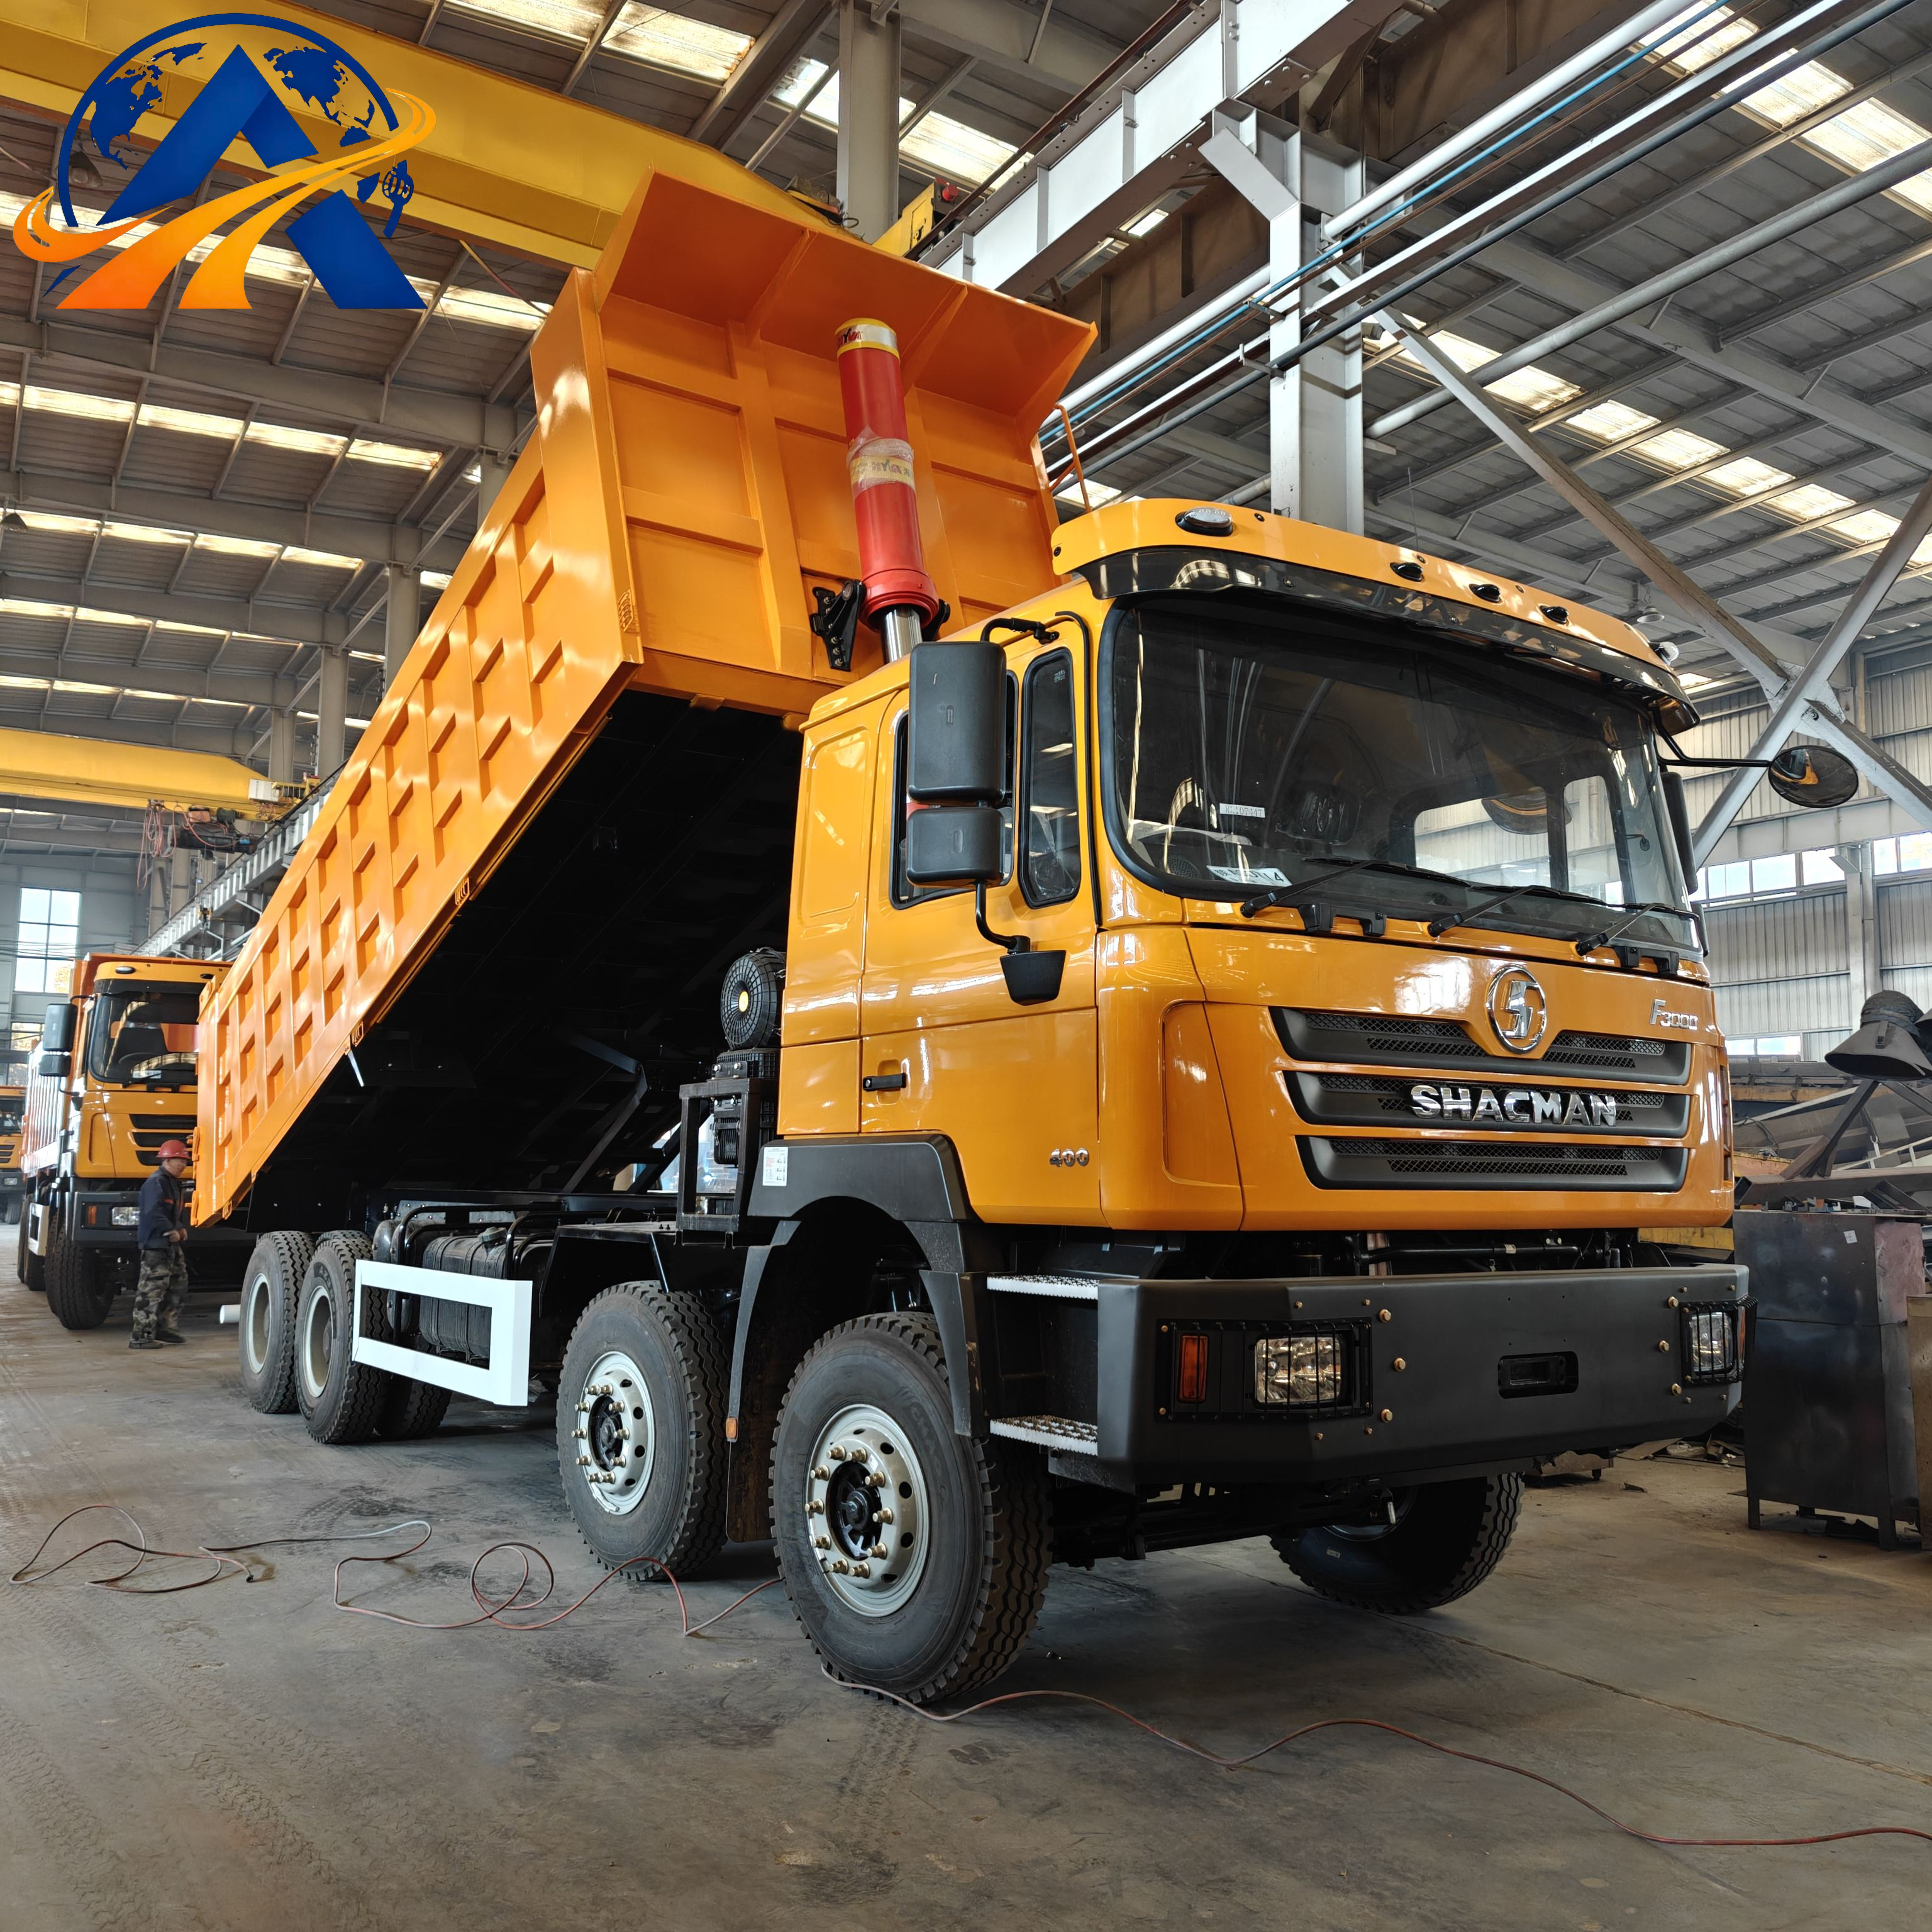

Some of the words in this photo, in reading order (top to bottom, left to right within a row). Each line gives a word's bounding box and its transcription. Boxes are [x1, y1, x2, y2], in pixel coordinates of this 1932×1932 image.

[1650, 999, 1698, 1030] F3000
[1411, 1085, 1617, 1126] SHACMAN
[1049, 1147, 1089, 1167] 400
